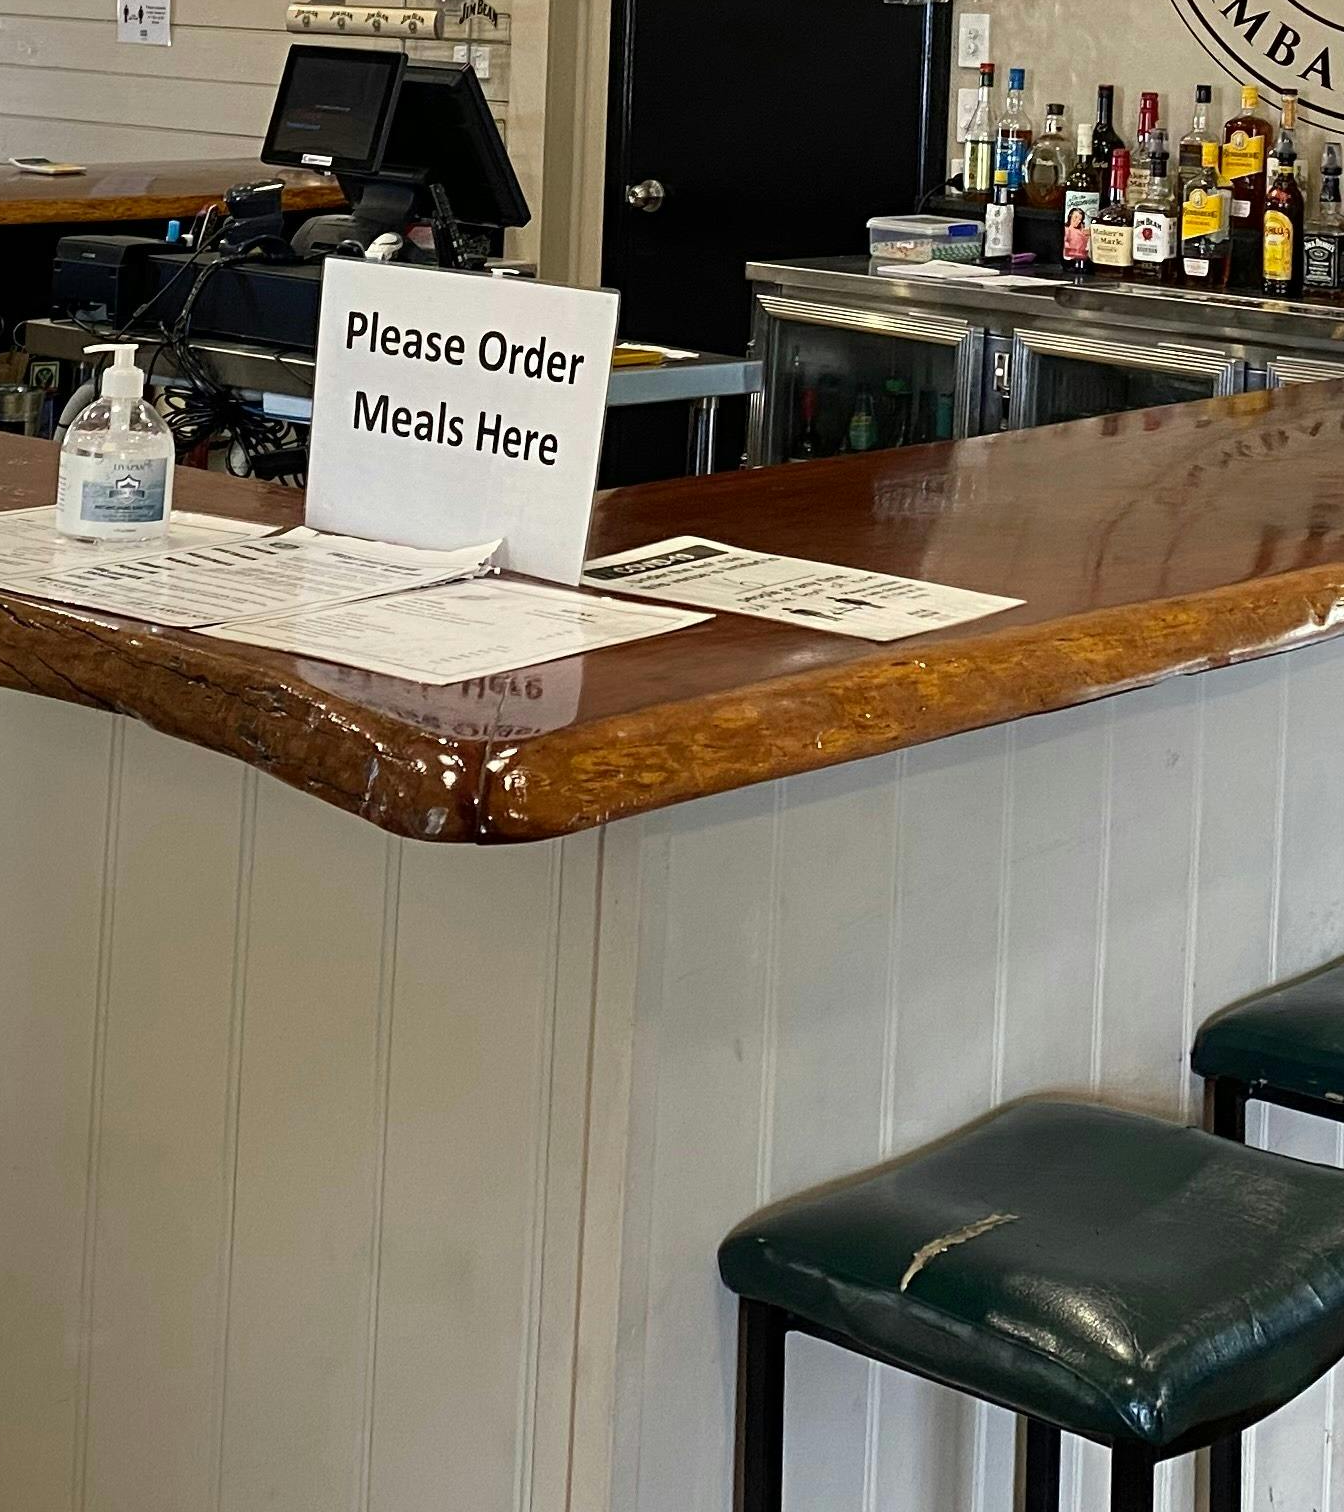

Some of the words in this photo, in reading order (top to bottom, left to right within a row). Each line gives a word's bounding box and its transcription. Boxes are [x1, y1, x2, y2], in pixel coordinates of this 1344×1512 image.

[346, 311, 465, 366] Please
[478, 330, 585, 386] Order
[353, 390, 464, 447] Meals
[475, 412, 559, 466] Here
